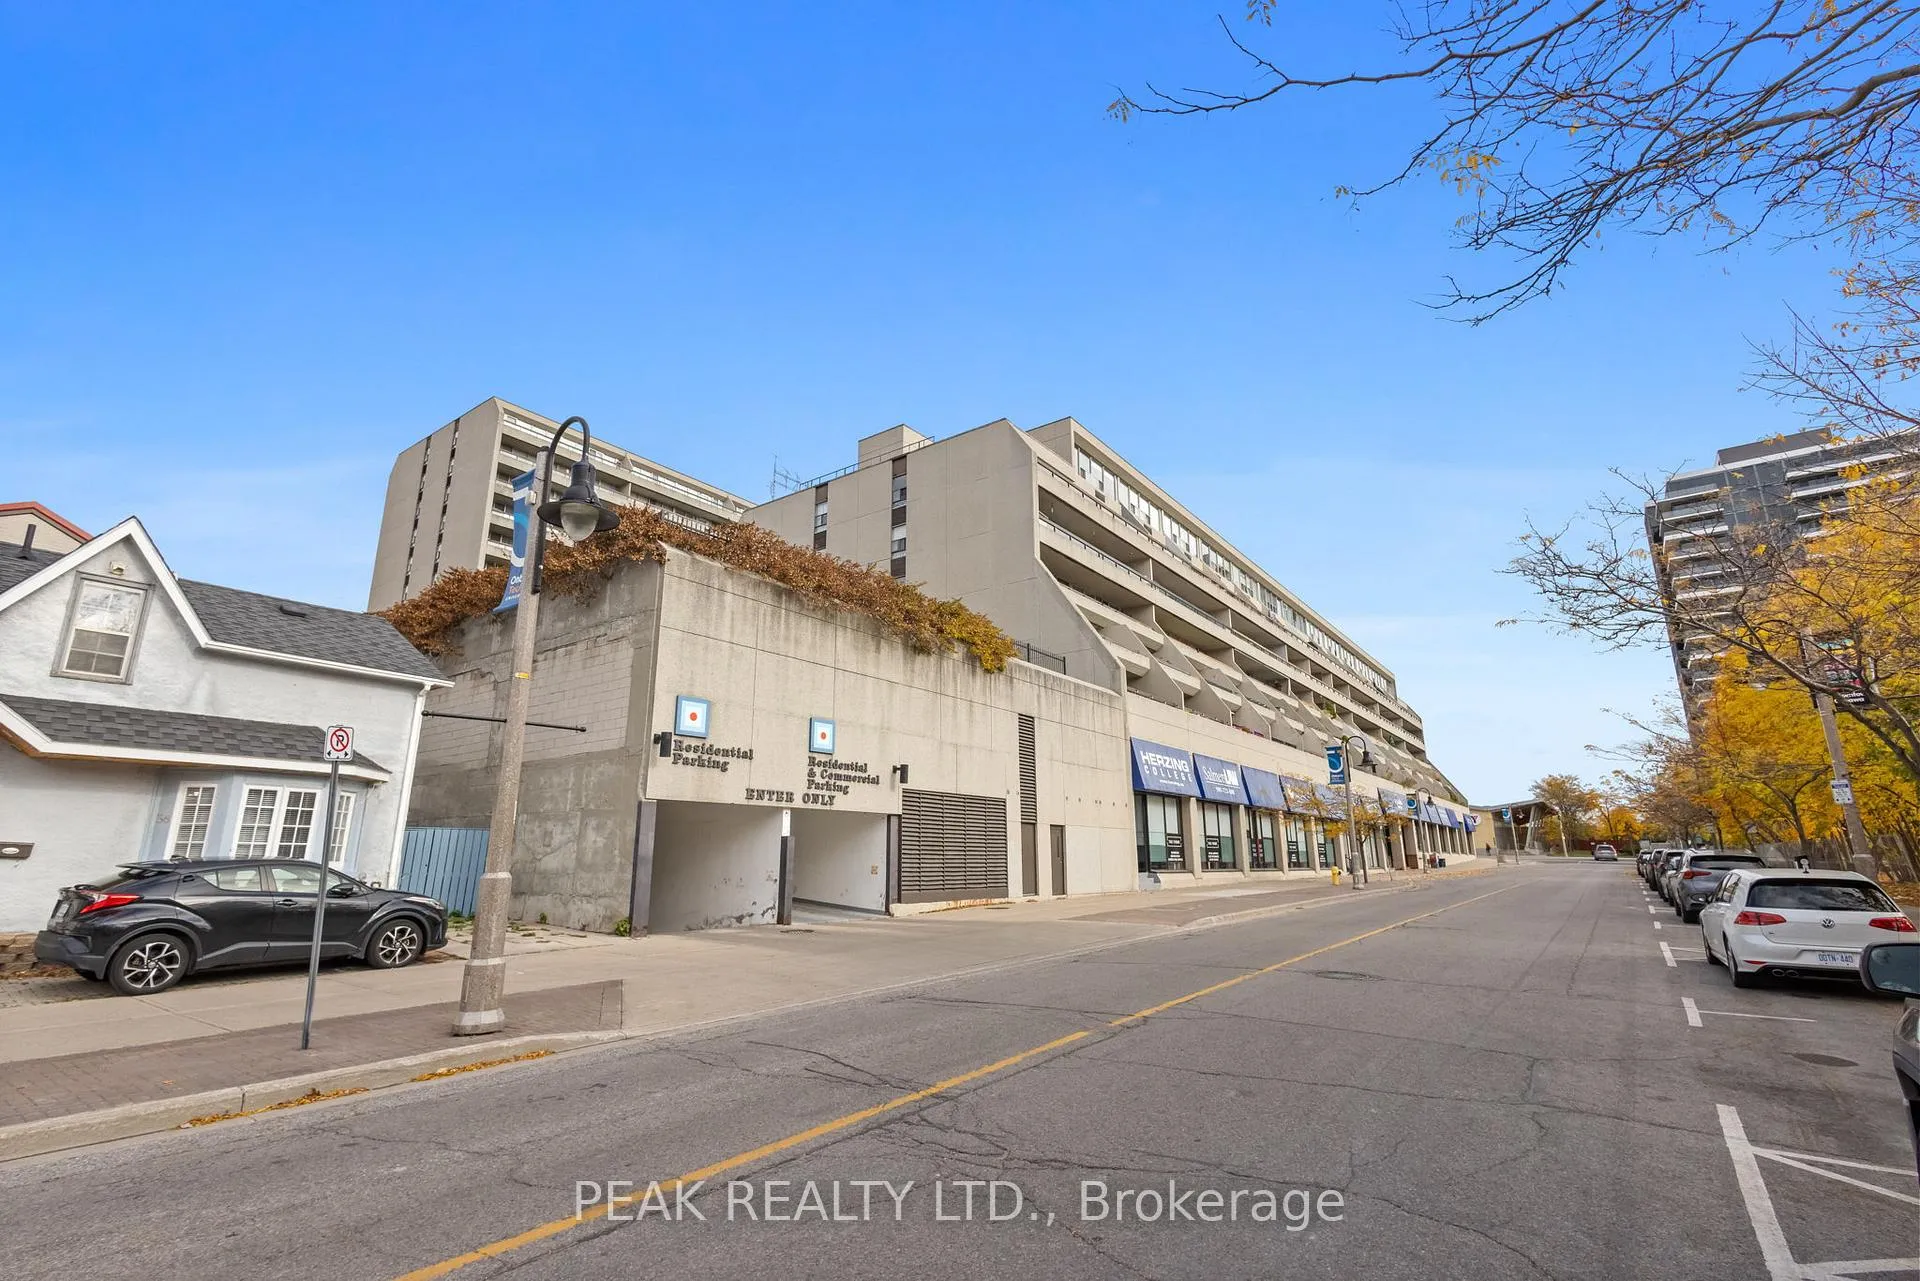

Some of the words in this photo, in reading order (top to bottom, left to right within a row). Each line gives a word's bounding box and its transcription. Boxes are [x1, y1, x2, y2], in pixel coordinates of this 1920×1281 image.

[673, 739, 753, 760] Residential
[672, 752, 730, 773] Parking
[807, 755, 868, 774] Residential
[1140, 750, 1190, 773] HERZING
[807, 767, 817, 778] &
[820, 768, 880, 785] Commercial
[1144, 764, 1193, 782] COLLEGE
[807, 778, 850, 795] Parking
[745, 787, 795, 803] ENTER
[802, 792, 836, 806] ONLY
